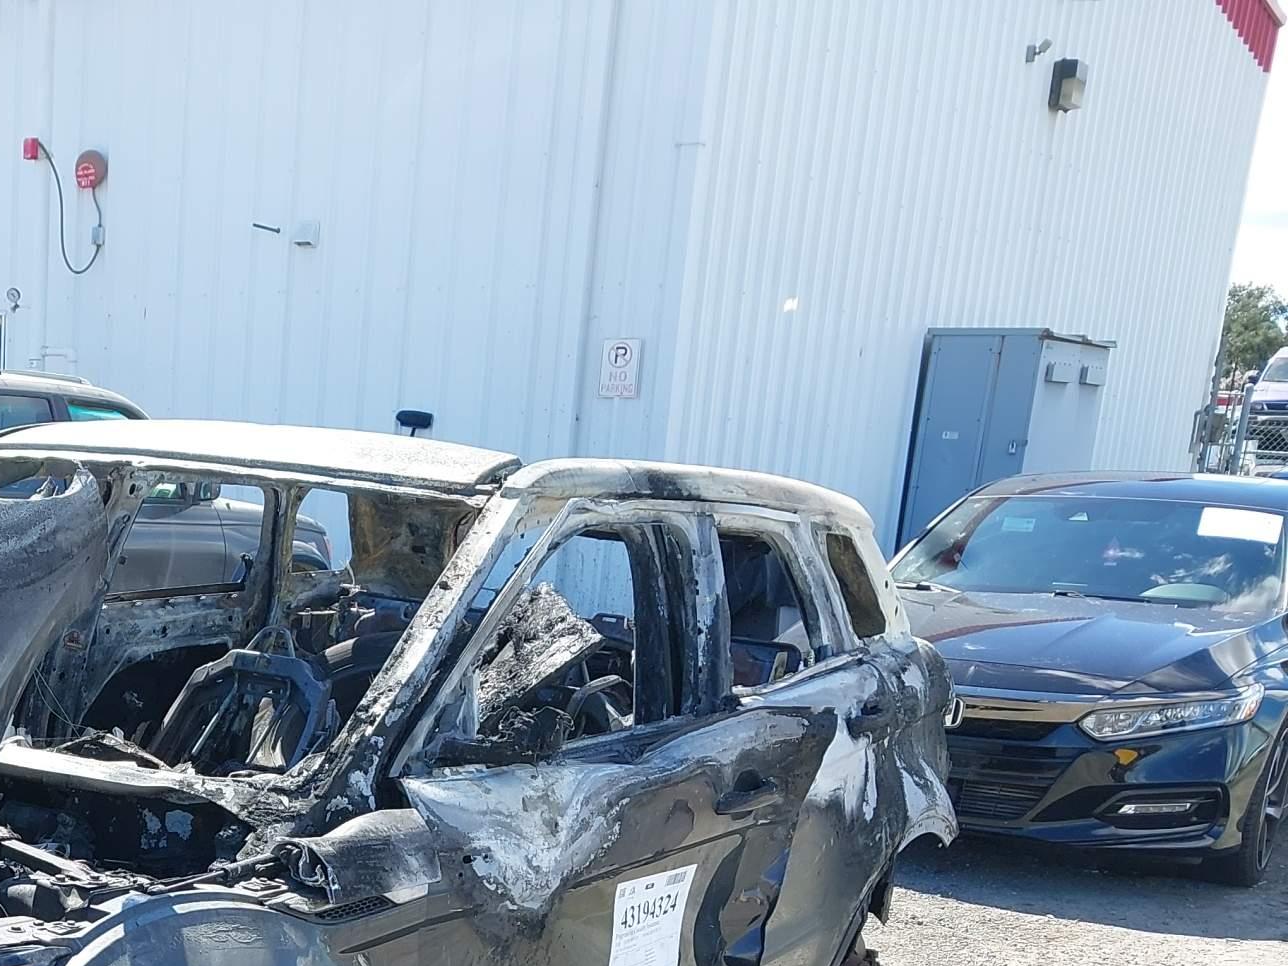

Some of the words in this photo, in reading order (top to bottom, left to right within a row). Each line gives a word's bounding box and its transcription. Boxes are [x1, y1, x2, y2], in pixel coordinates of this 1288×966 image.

[608, 370, 628, 382] NO
[600, 383, 633, 393] PARKING
[620, 889, 681, 929] 43194324
